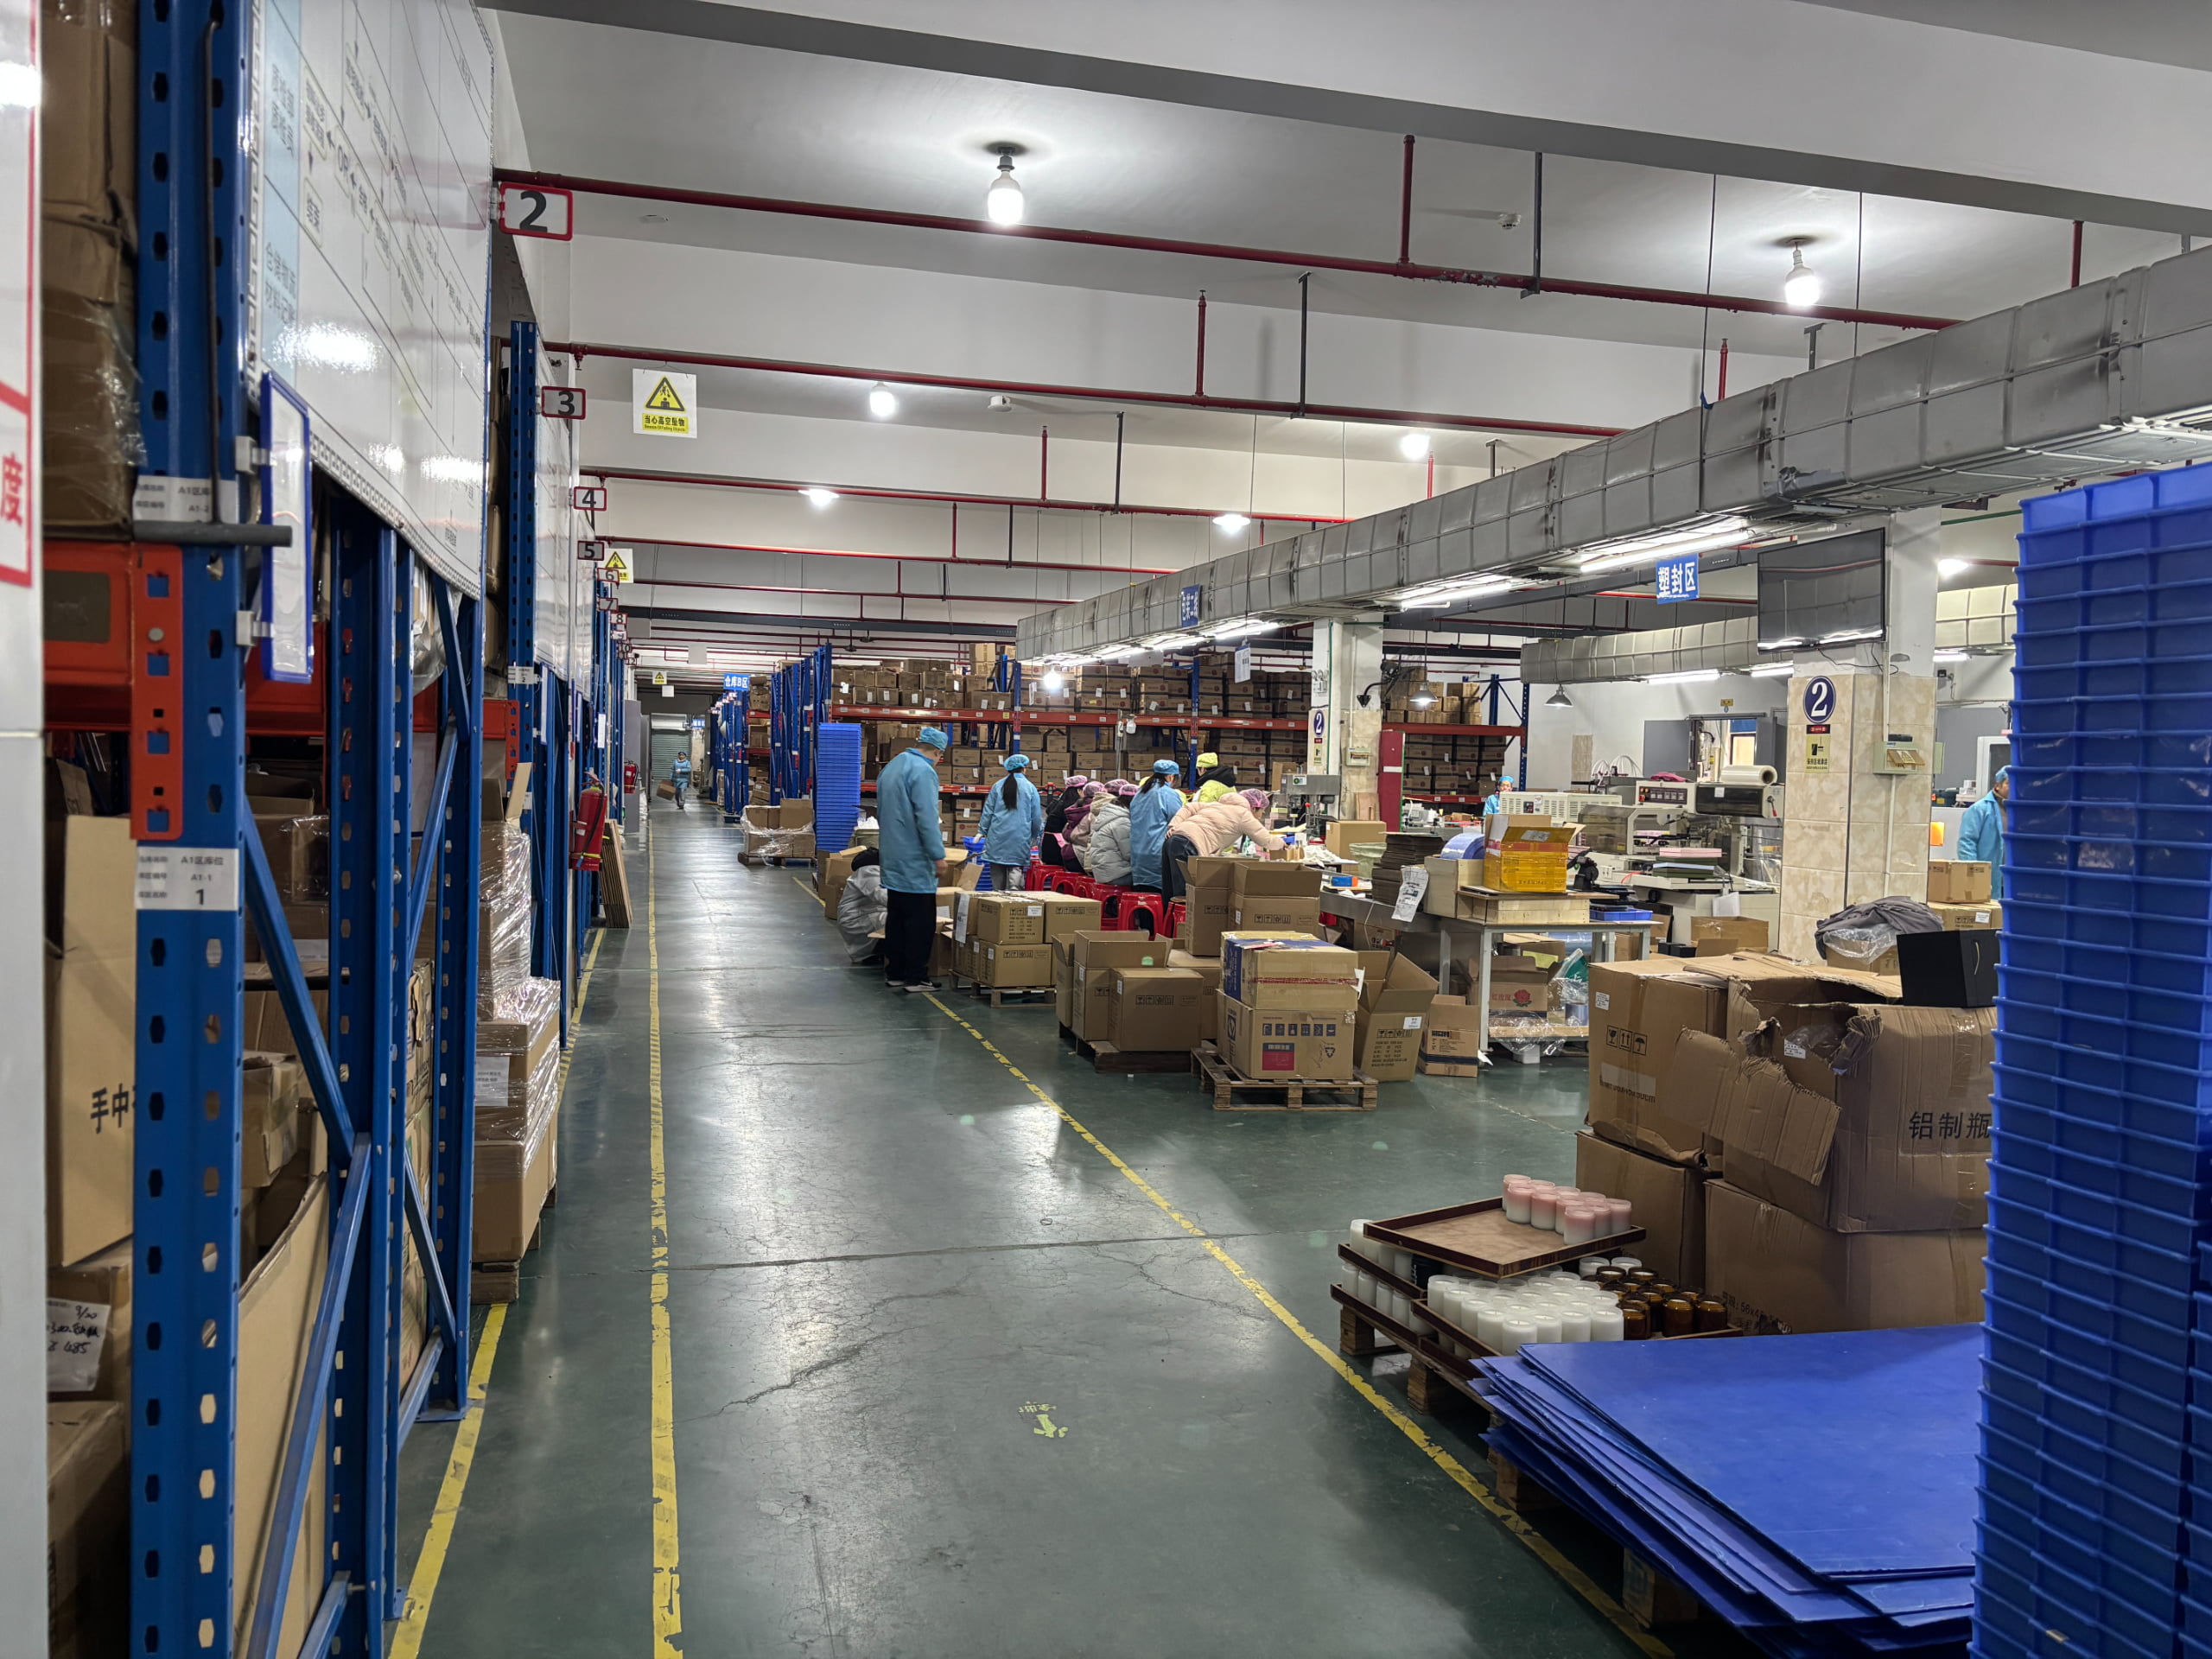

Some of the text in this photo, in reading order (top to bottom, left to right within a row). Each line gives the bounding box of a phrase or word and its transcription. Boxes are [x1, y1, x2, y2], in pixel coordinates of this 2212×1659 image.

[519, 190, 548, 232] 2
[557, 391, 575, 416] 3
[644, 414, 685, 426] 当心高空坠物
[2, 453, 22, 526] 度
[582, 489, 596, 508] 4
[584, 543, 595, 559] 5
[605, 571, 614, 581] 6
[1658, 562, 1696, 596] 塑封区
[606, 599, 614, 609] 7
[616, 614, 624, 623] 8
[725, 676, 747, 689] 仓库B区
[1810, 682, 1828, 717] 2
[1315, 713, 1322, 734] 2
[195, 889, 204, 906] 1
[90, 1083, 136, 1135] 手中
[1909, 1111, 1992, 1140] 铝制瓶
